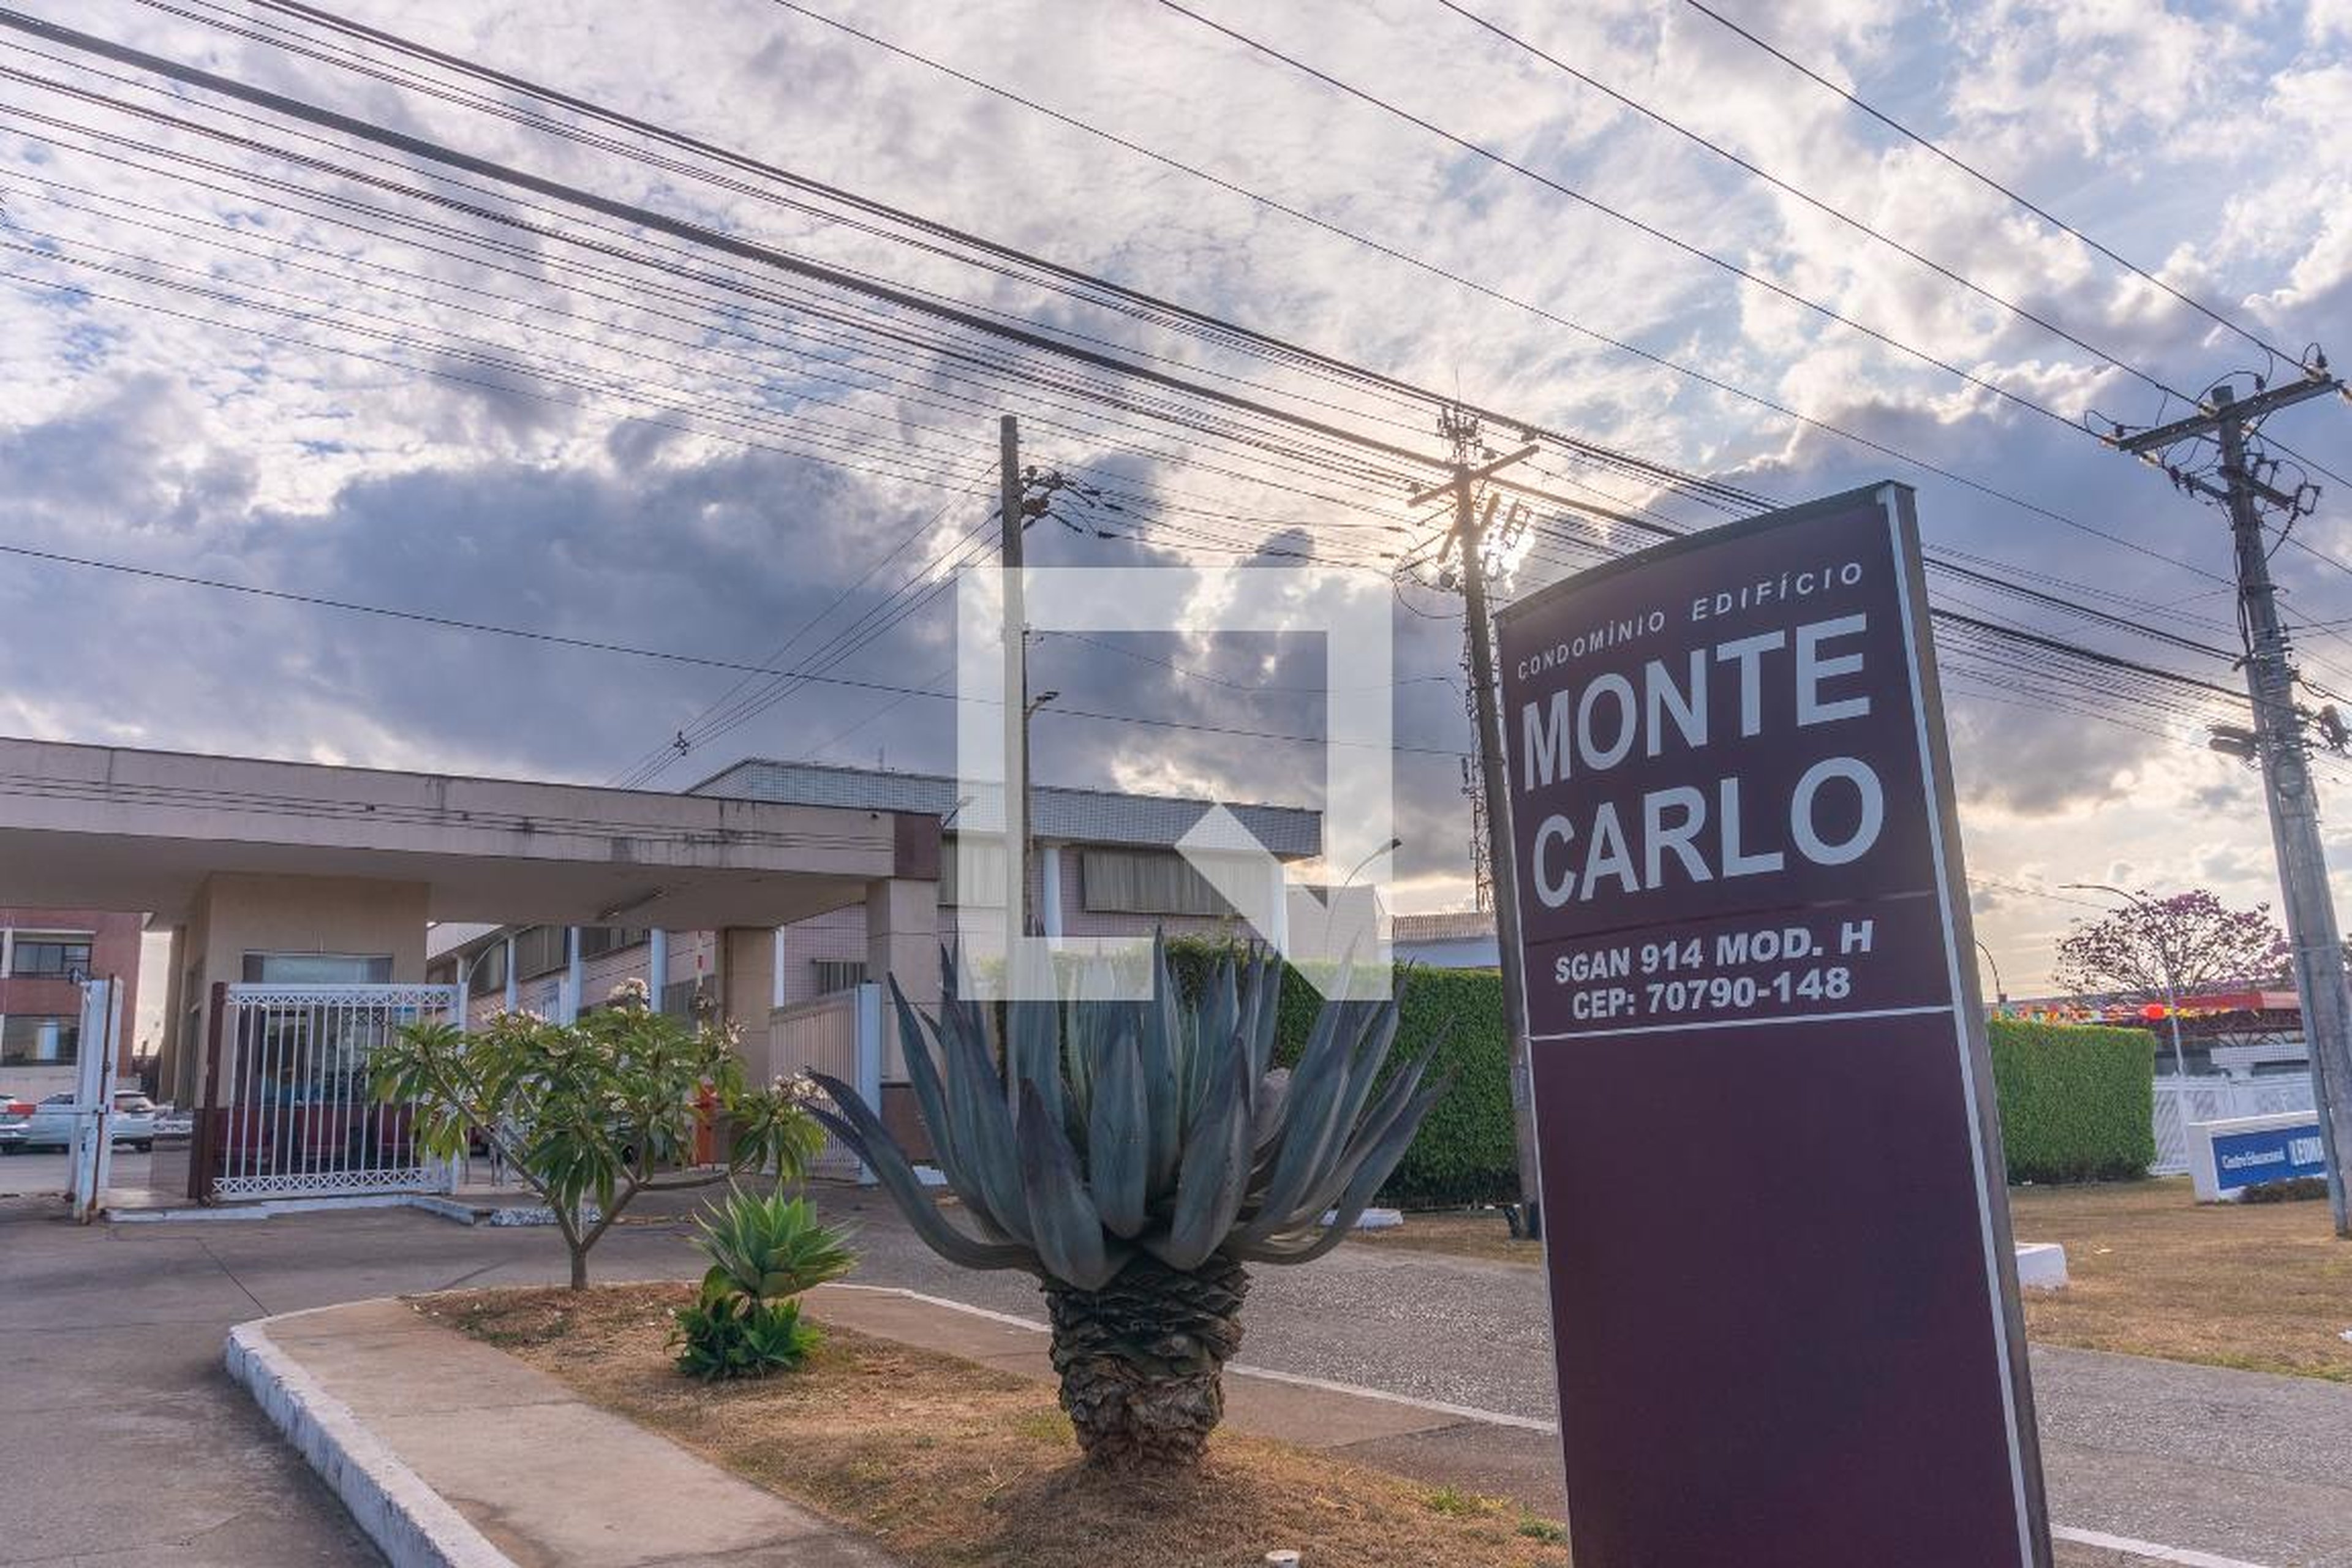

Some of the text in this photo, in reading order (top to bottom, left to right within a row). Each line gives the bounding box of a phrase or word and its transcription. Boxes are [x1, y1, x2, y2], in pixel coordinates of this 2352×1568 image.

[1517, 562, 1863, 680] CONDOMÍNIO EDIFÍCIO
[1522, 612, 1871, 791] MONTE
[1533, 756, 1884, 908] CARLO
[1555, 920, 1874, 984] SGAN 914 MOD. H
[1572, 967, 1851, 1020] CEP: 70790-148
